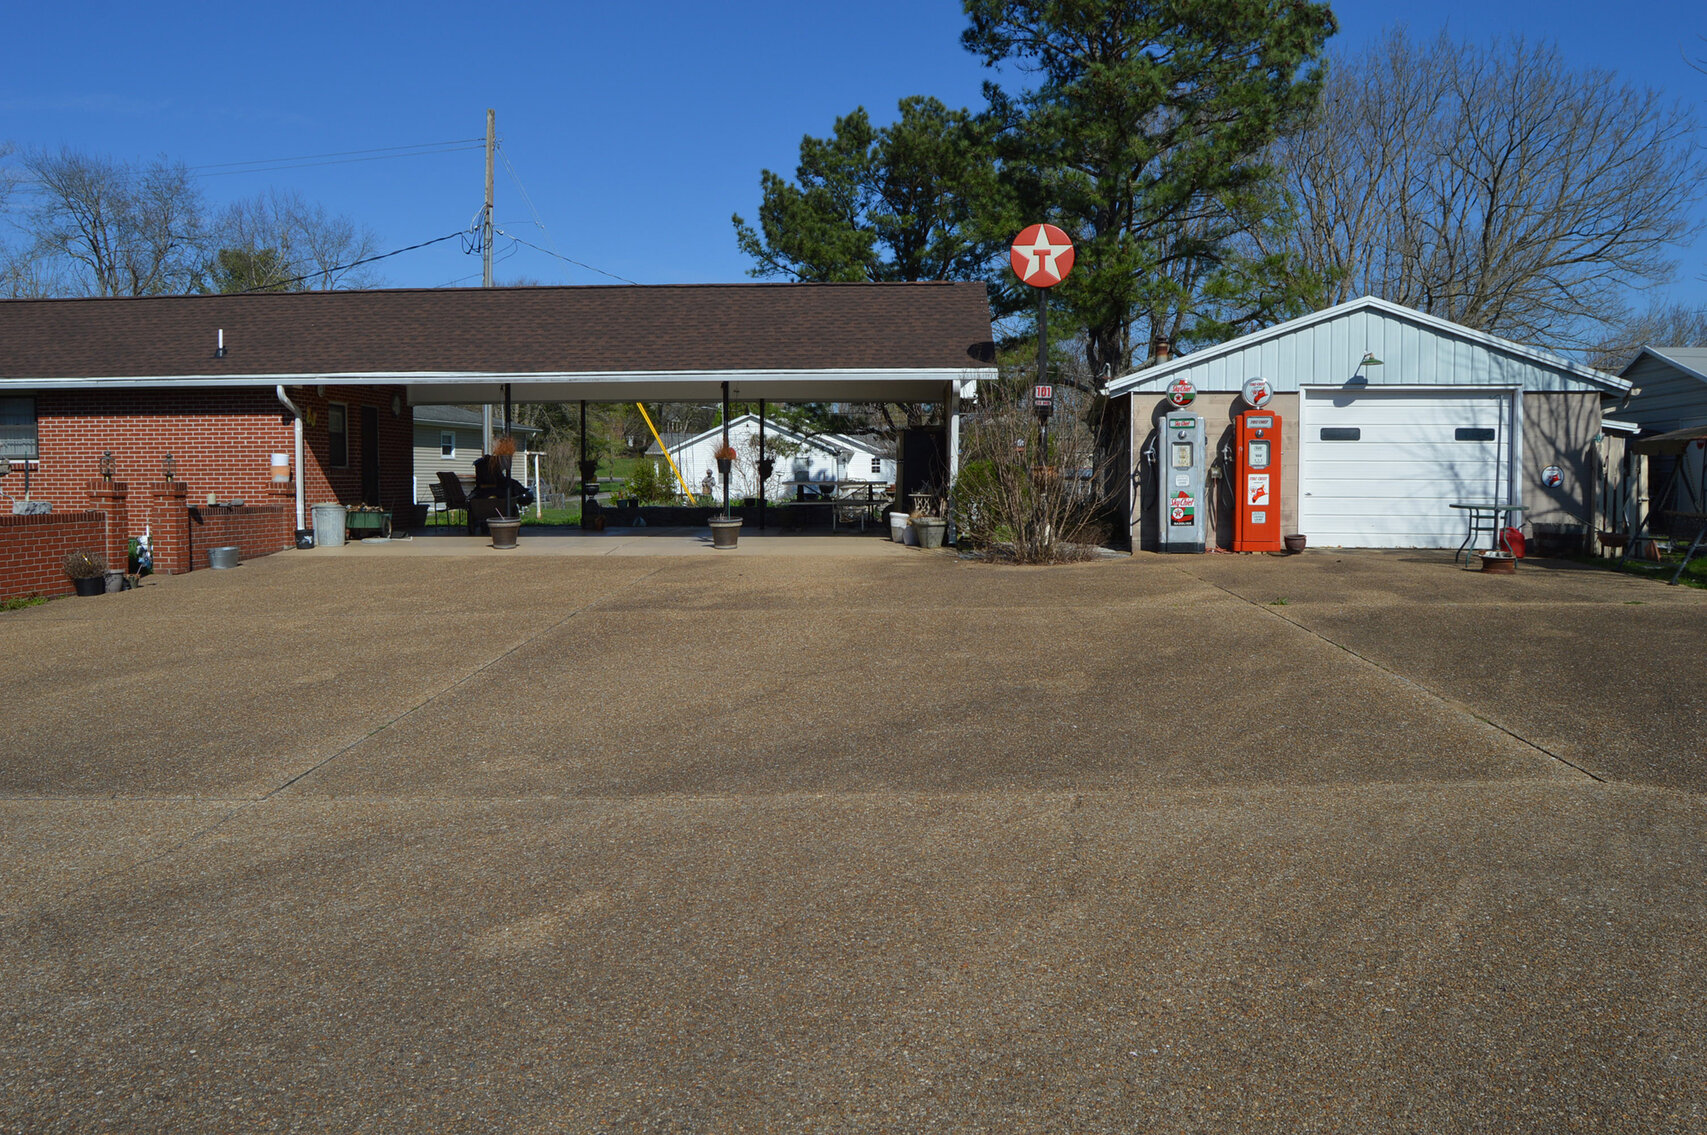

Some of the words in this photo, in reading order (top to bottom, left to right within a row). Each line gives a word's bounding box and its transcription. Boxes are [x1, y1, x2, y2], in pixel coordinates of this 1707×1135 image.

[1033, 249, 1051, 271] T
[1037, 387, 1051, 397] 101
[1180, 384, 1192, 392] Chief
[1171, 498, 1180, 507] Sky
[1180, 498, 1194, 506] Chief
